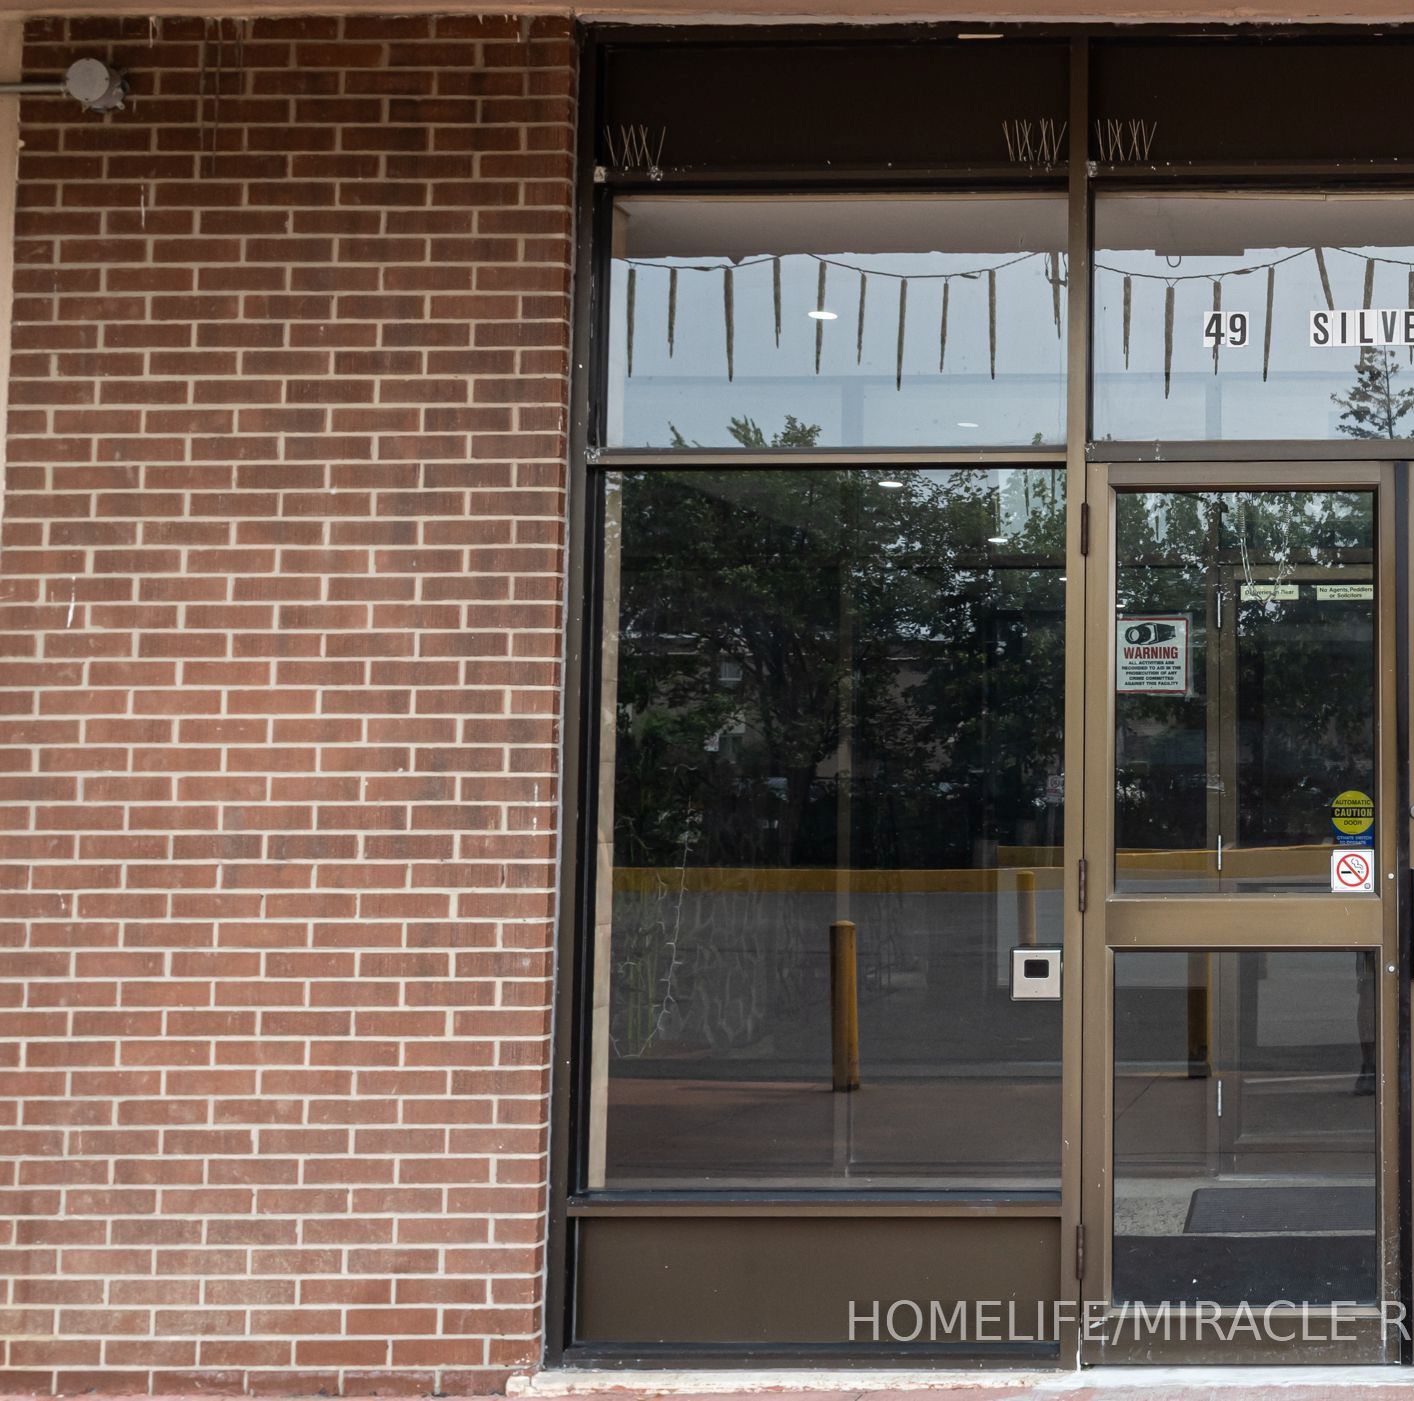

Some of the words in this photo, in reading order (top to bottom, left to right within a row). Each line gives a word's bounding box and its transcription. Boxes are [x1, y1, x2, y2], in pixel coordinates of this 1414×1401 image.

[1204, 313, 1248, 346] 49
[1123, 646, 1179, 660] WARNING
[1334, 808, 1373, 817] CAUTION
